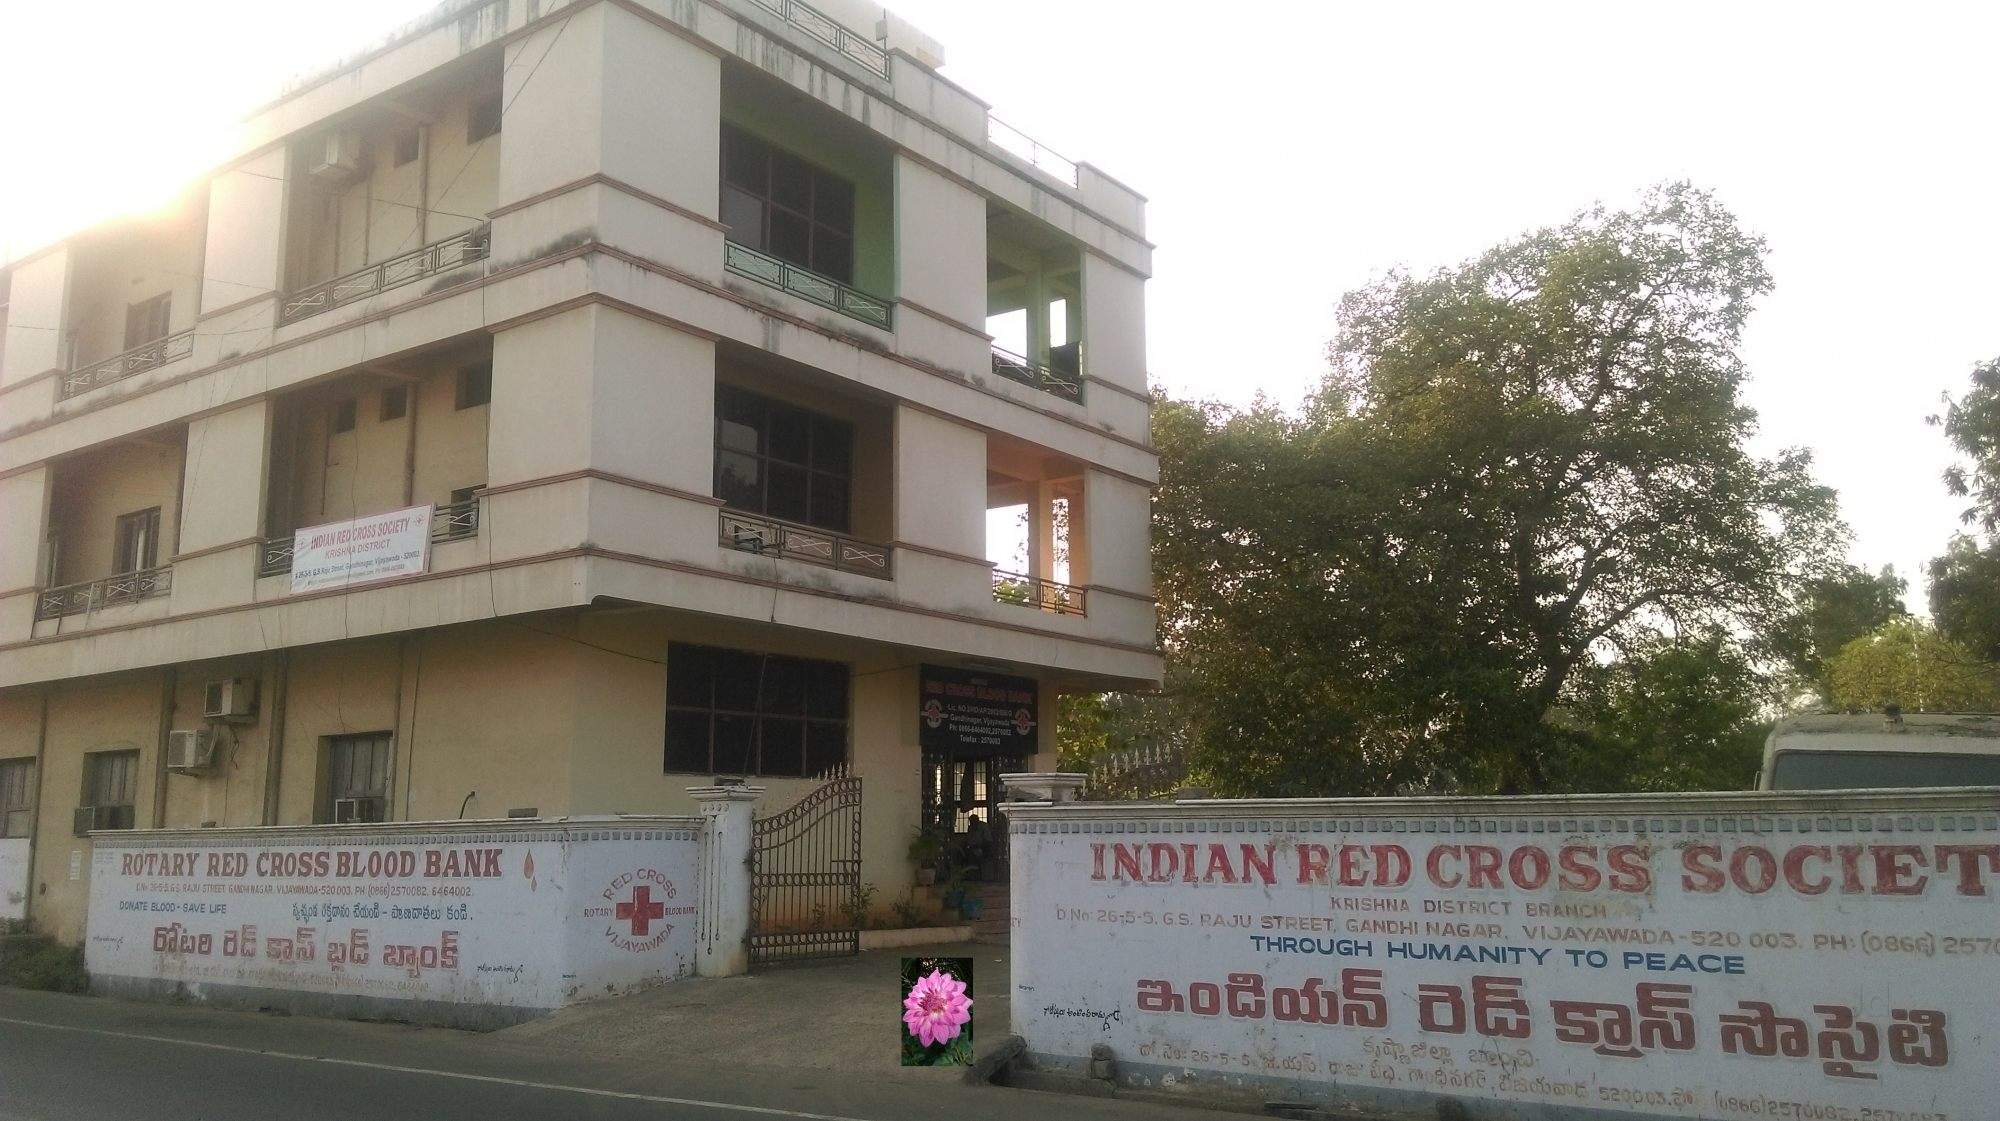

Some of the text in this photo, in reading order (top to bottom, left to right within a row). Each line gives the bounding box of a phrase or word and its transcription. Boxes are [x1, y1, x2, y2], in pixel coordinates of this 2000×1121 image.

[310, 517, 410, 550] INDIAN RED CROSS SOCIETY
[325, 538, 391, 560] KRISHNA DISTRICT
[121, 853, 199, 877] ROTARY
[206, 852, 249, 877] RED
[256, 852, 330, 878] CROSS
[335, 850, 416, 878] BLOOD
[424, 849, 503, 878] BANK
[1090, 842, 2000, 896] INDIAN RED CROSS SOCIET
[602, 868, 676, 900] RED CROSS
[119, 900, 148, 912] DONATE
[151, 902, 175, 913] BLOOD
[183, 904, 205, 914] SAVE
[210, 904, 226, 914] LIFE
[584, 908, 613, 918] ROTARY
[1331, 897, 1607, 918] KRISHNA DISTRICT BRANCH
[1200, 913, 1252, 928] RAJU
[1346, 918, 1418, 934] GANDHI
[605, 926, 675, 953] VIJAYAWADA
[1250, 936, 1746, 974] THROUGH HUMANITY TO PEACE
[1137, 968, 1387, 1027] ఇండియన్
[1418, 975, 1532, 1038] రెడ్
